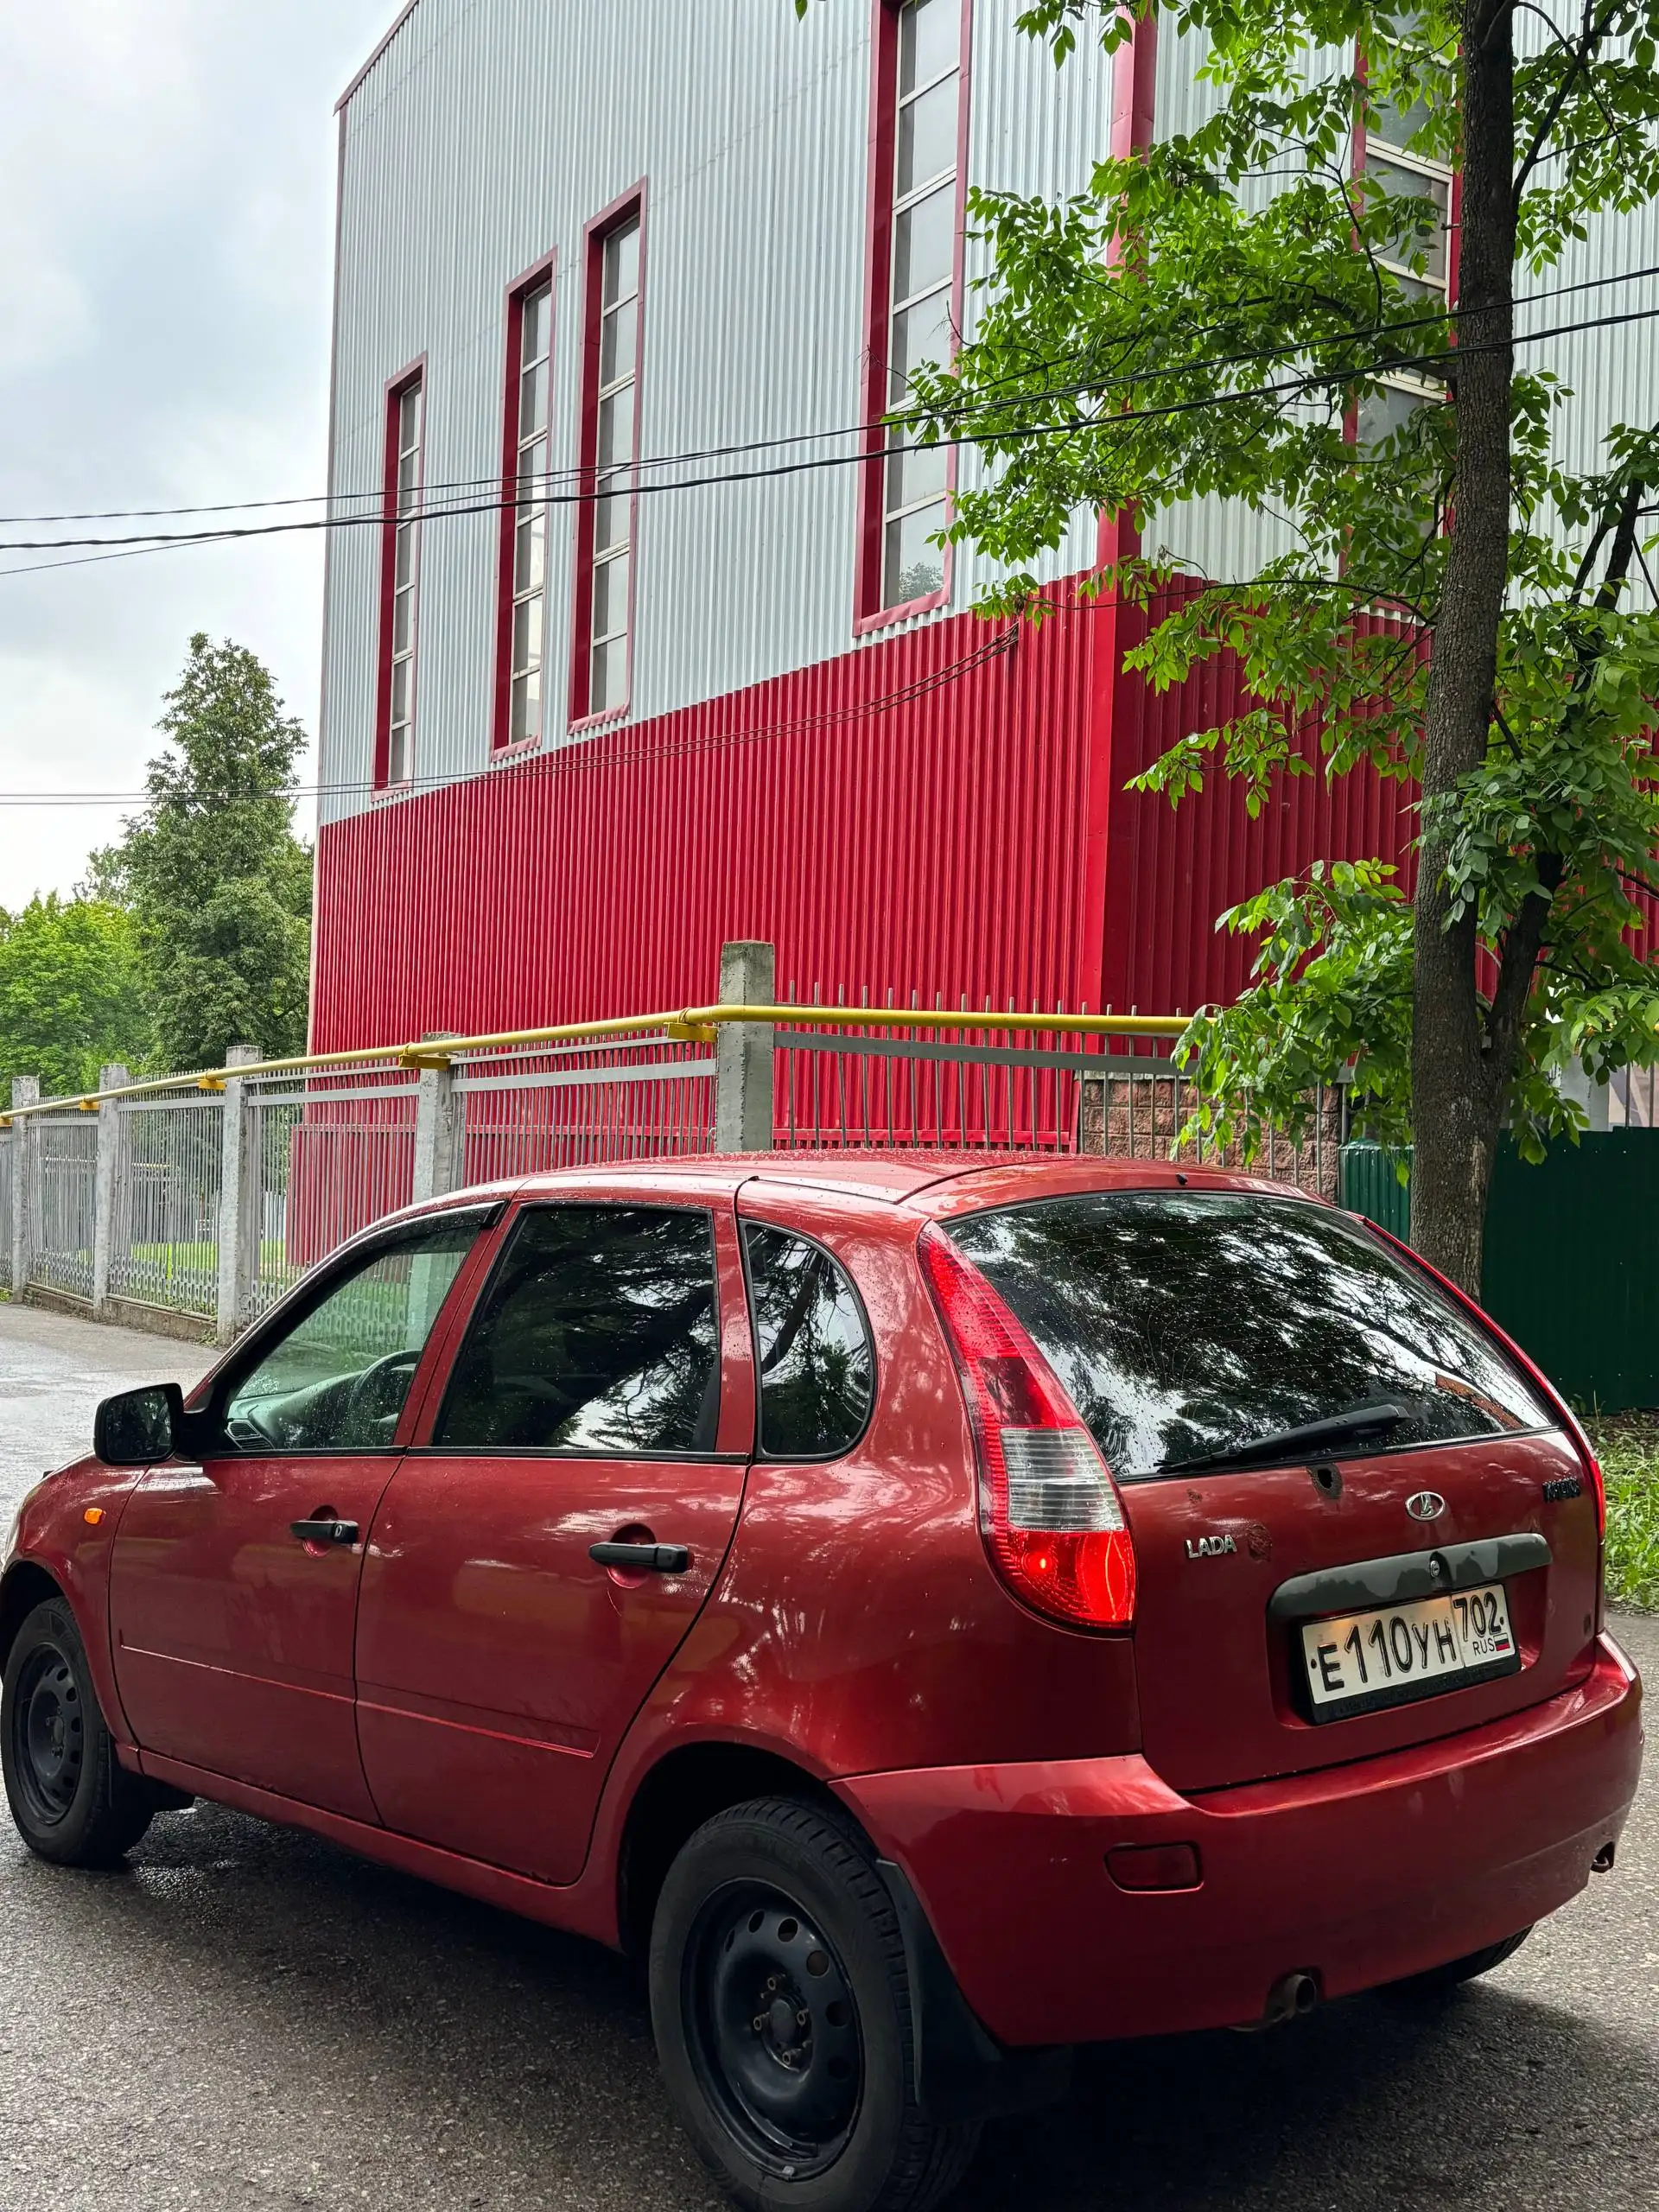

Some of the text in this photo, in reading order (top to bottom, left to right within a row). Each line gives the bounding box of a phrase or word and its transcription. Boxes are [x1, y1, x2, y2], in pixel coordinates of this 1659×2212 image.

[1184, 1535, 1237, 1558] LADA
[1453, 1592, 1502, 1642] 702
[1473, 1640, 1496, 1656] RUS
